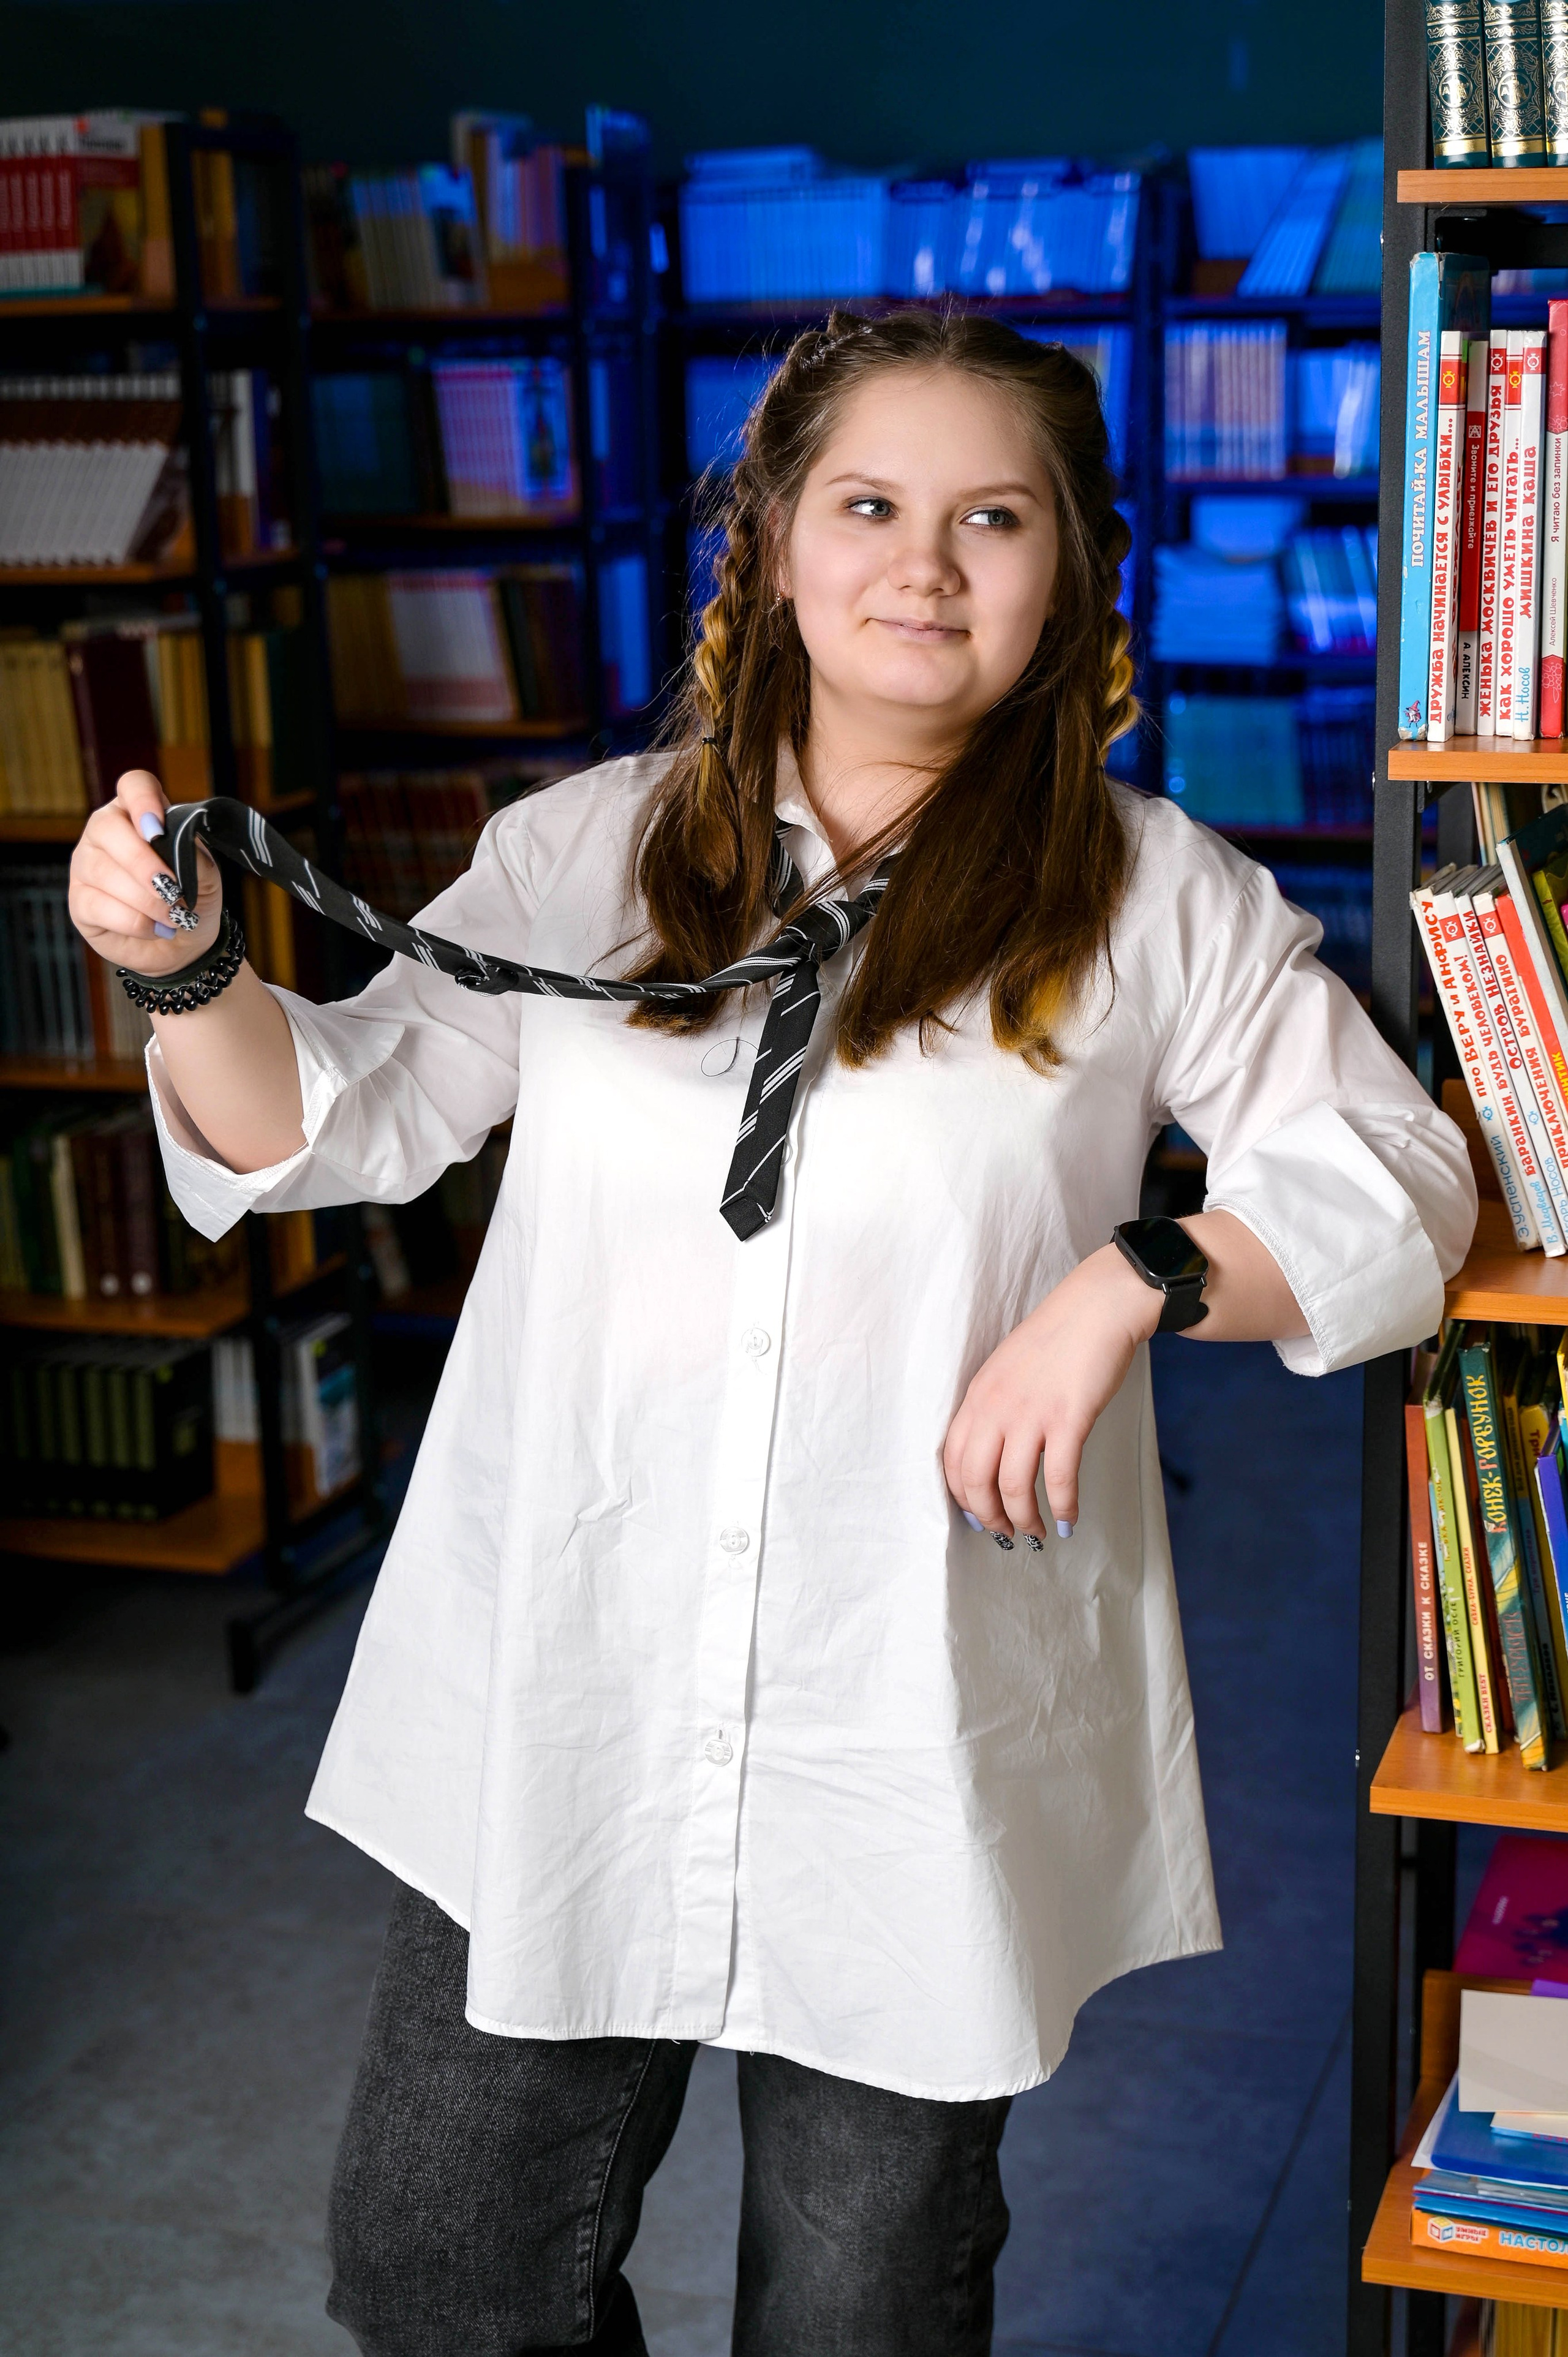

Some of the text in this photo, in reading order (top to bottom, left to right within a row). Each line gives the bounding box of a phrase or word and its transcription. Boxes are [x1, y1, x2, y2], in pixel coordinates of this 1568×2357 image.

[1411, 330, 1431, 568] ПОЧИТАЙ-КА МАЛЫШАМ
[1488, 385, 1502, 458] ДРУЗЬЯ
[1470, 443, 1480, 483] Звоните
[1487, 463, 1499, 492] ЕГО
[1551, 481, 1561, 499] без
[1502, 529, 1517, 591] УМЕТЬ
[1520, 446, 1536, 619] МИШКИНА КАША
[1433, 532, 1449, 643] НАЧИНАЕТСЯ
[1501, 597, 1515, 677] ХОРОШО
[1430, 648, 1444, 724] ДРУЖБА
[1461, 655, 1471, 700] АЛЕКСИН
[1480, 641, 1493, 717] ЖЕНЬКА
[1499, 684, 1512, 720] КАК
[1515, 667, 1530, 704] Носов
[1421, 900, 1457, 990] АНФИСУ
[1463, 910, 1523, 1070] ОСТРОВ НЕЗНАЙКИ
[1496, 954, 1531, 1038] БУРАТИНО
[1454, 1011, 1478, 1063] ВЕРУ
[1488, 1049, 1508, 1091] БУДЬ
[1471, 1066, 1488, 1098] ПРО
[1418, 1541, 1435, 1681] ОТ СКАЗКИ К СКАЗКЕ
